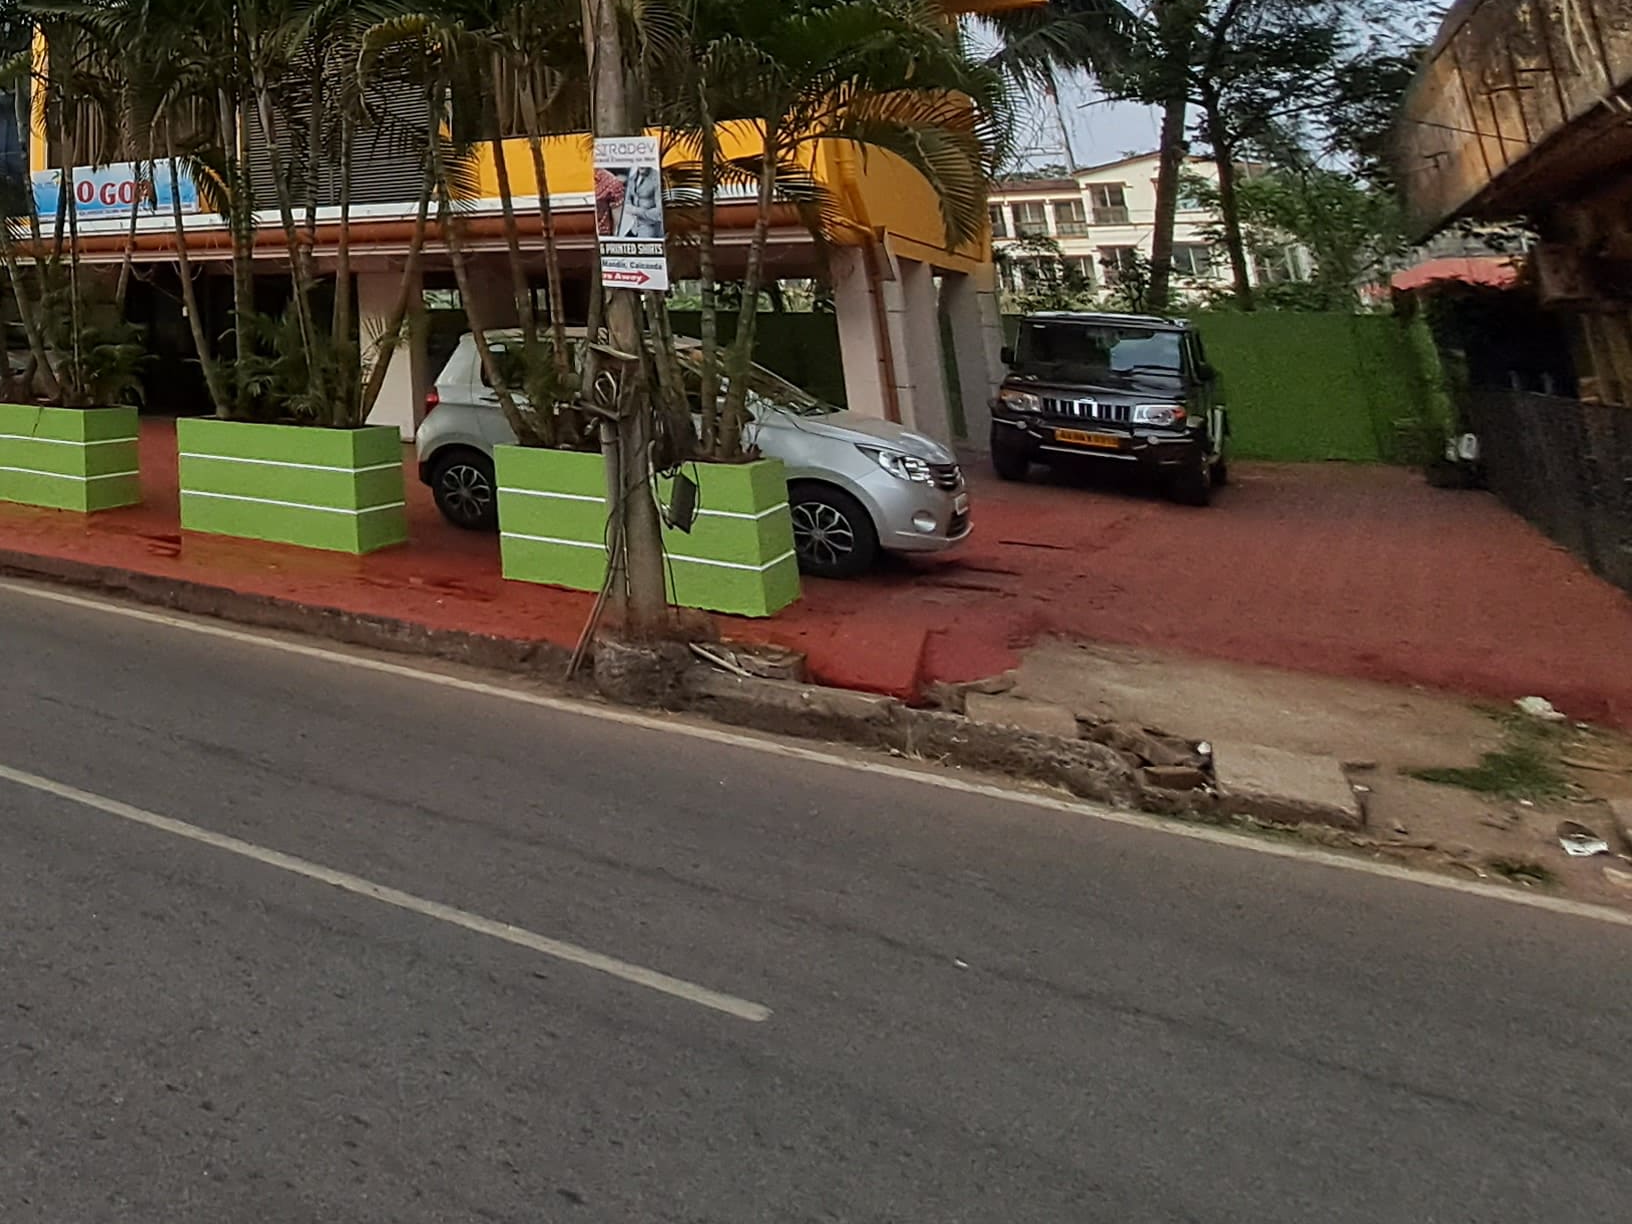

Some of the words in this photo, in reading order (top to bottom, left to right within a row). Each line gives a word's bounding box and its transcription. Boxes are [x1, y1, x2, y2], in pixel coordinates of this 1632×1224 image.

[605, 243, 637, 255] PRINTED
[637, 243, 663, 255] SHIRTS
[614, 272, 643, 283] Away
